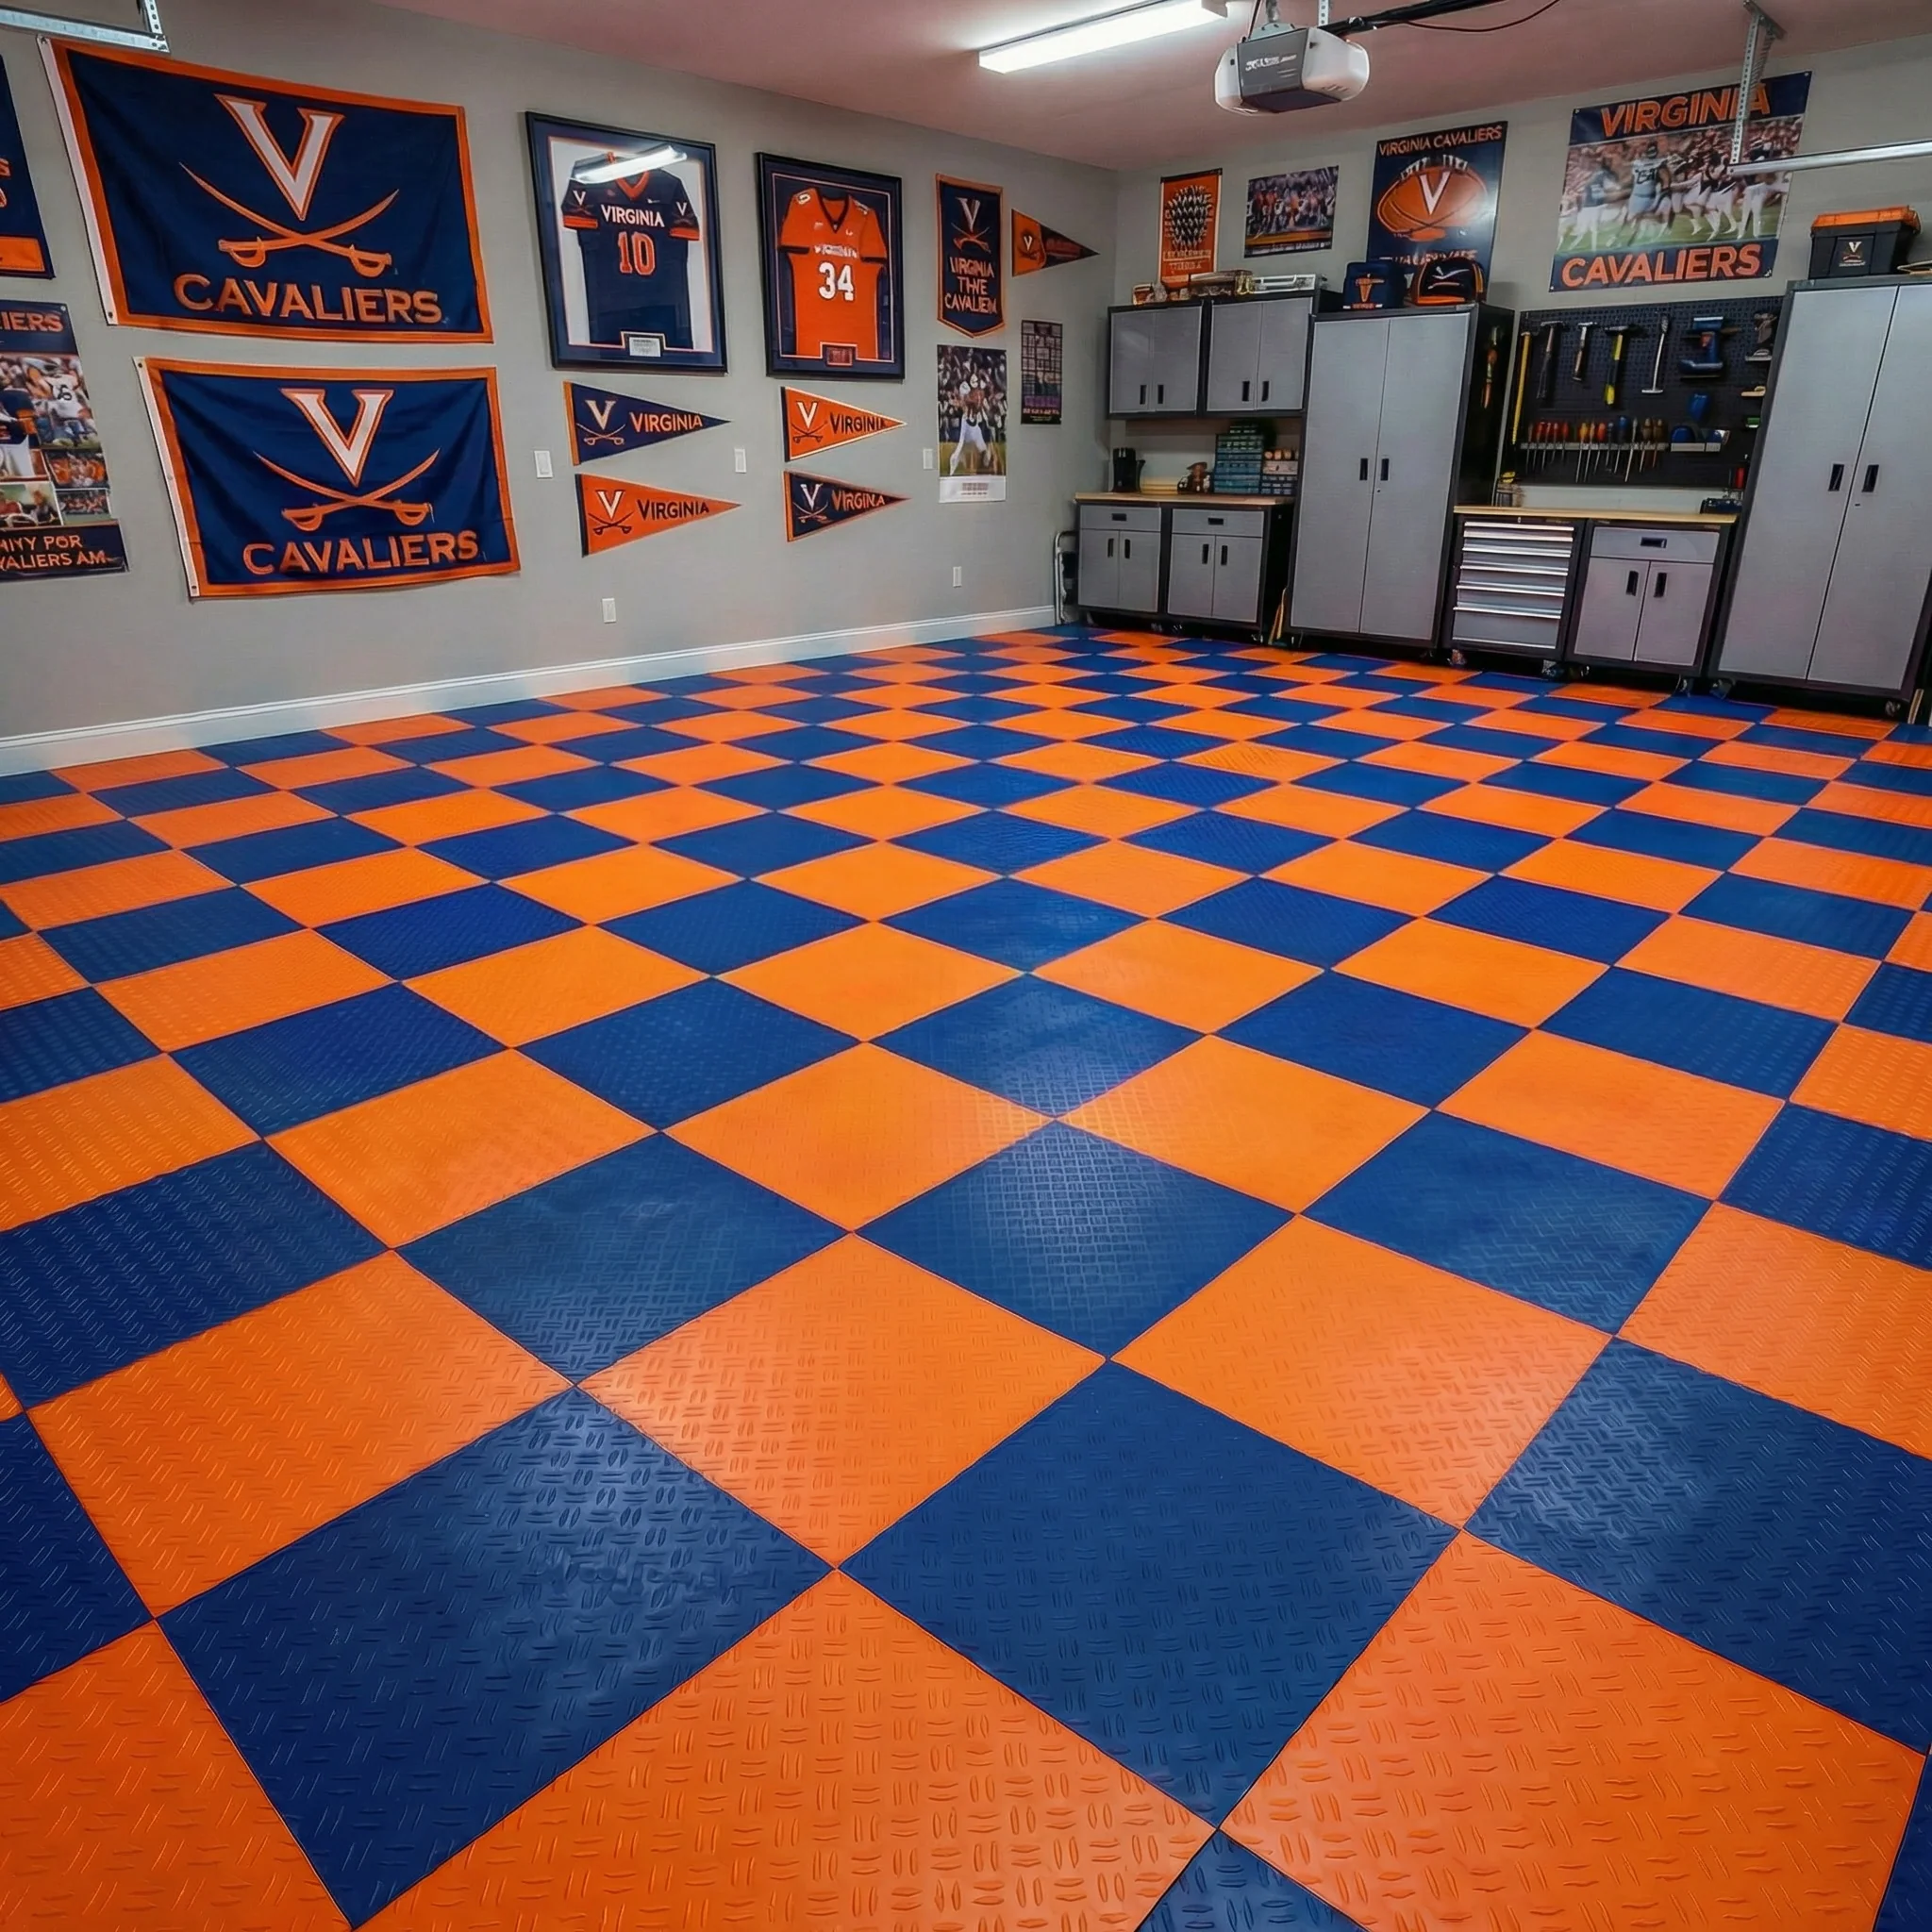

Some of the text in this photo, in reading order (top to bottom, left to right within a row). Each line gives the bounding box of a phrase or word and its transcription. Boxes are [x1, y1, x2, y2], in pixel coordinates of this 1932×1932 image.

[213, 93, 346, 221] V
[1379, 125, 1502, 157] VIRGINIA CAVALIERS
[600, 204, 665, 228] VIRGINIA
[618, 231, 655, 275] 10
[1562, 243, 1761, 288] CAVALIERS
[174, 273, 442, 324] CAVALIERS
[818, 262, 854, 301] 34
[0, 310, 64, 333] IERS
[279, 388, 394, 488] V
[629, 412, 703, 433] VIRGINIA
[637, 499, 709, 521] VIRGINIA
[243, 530, 478, 575] CAVALIERS
